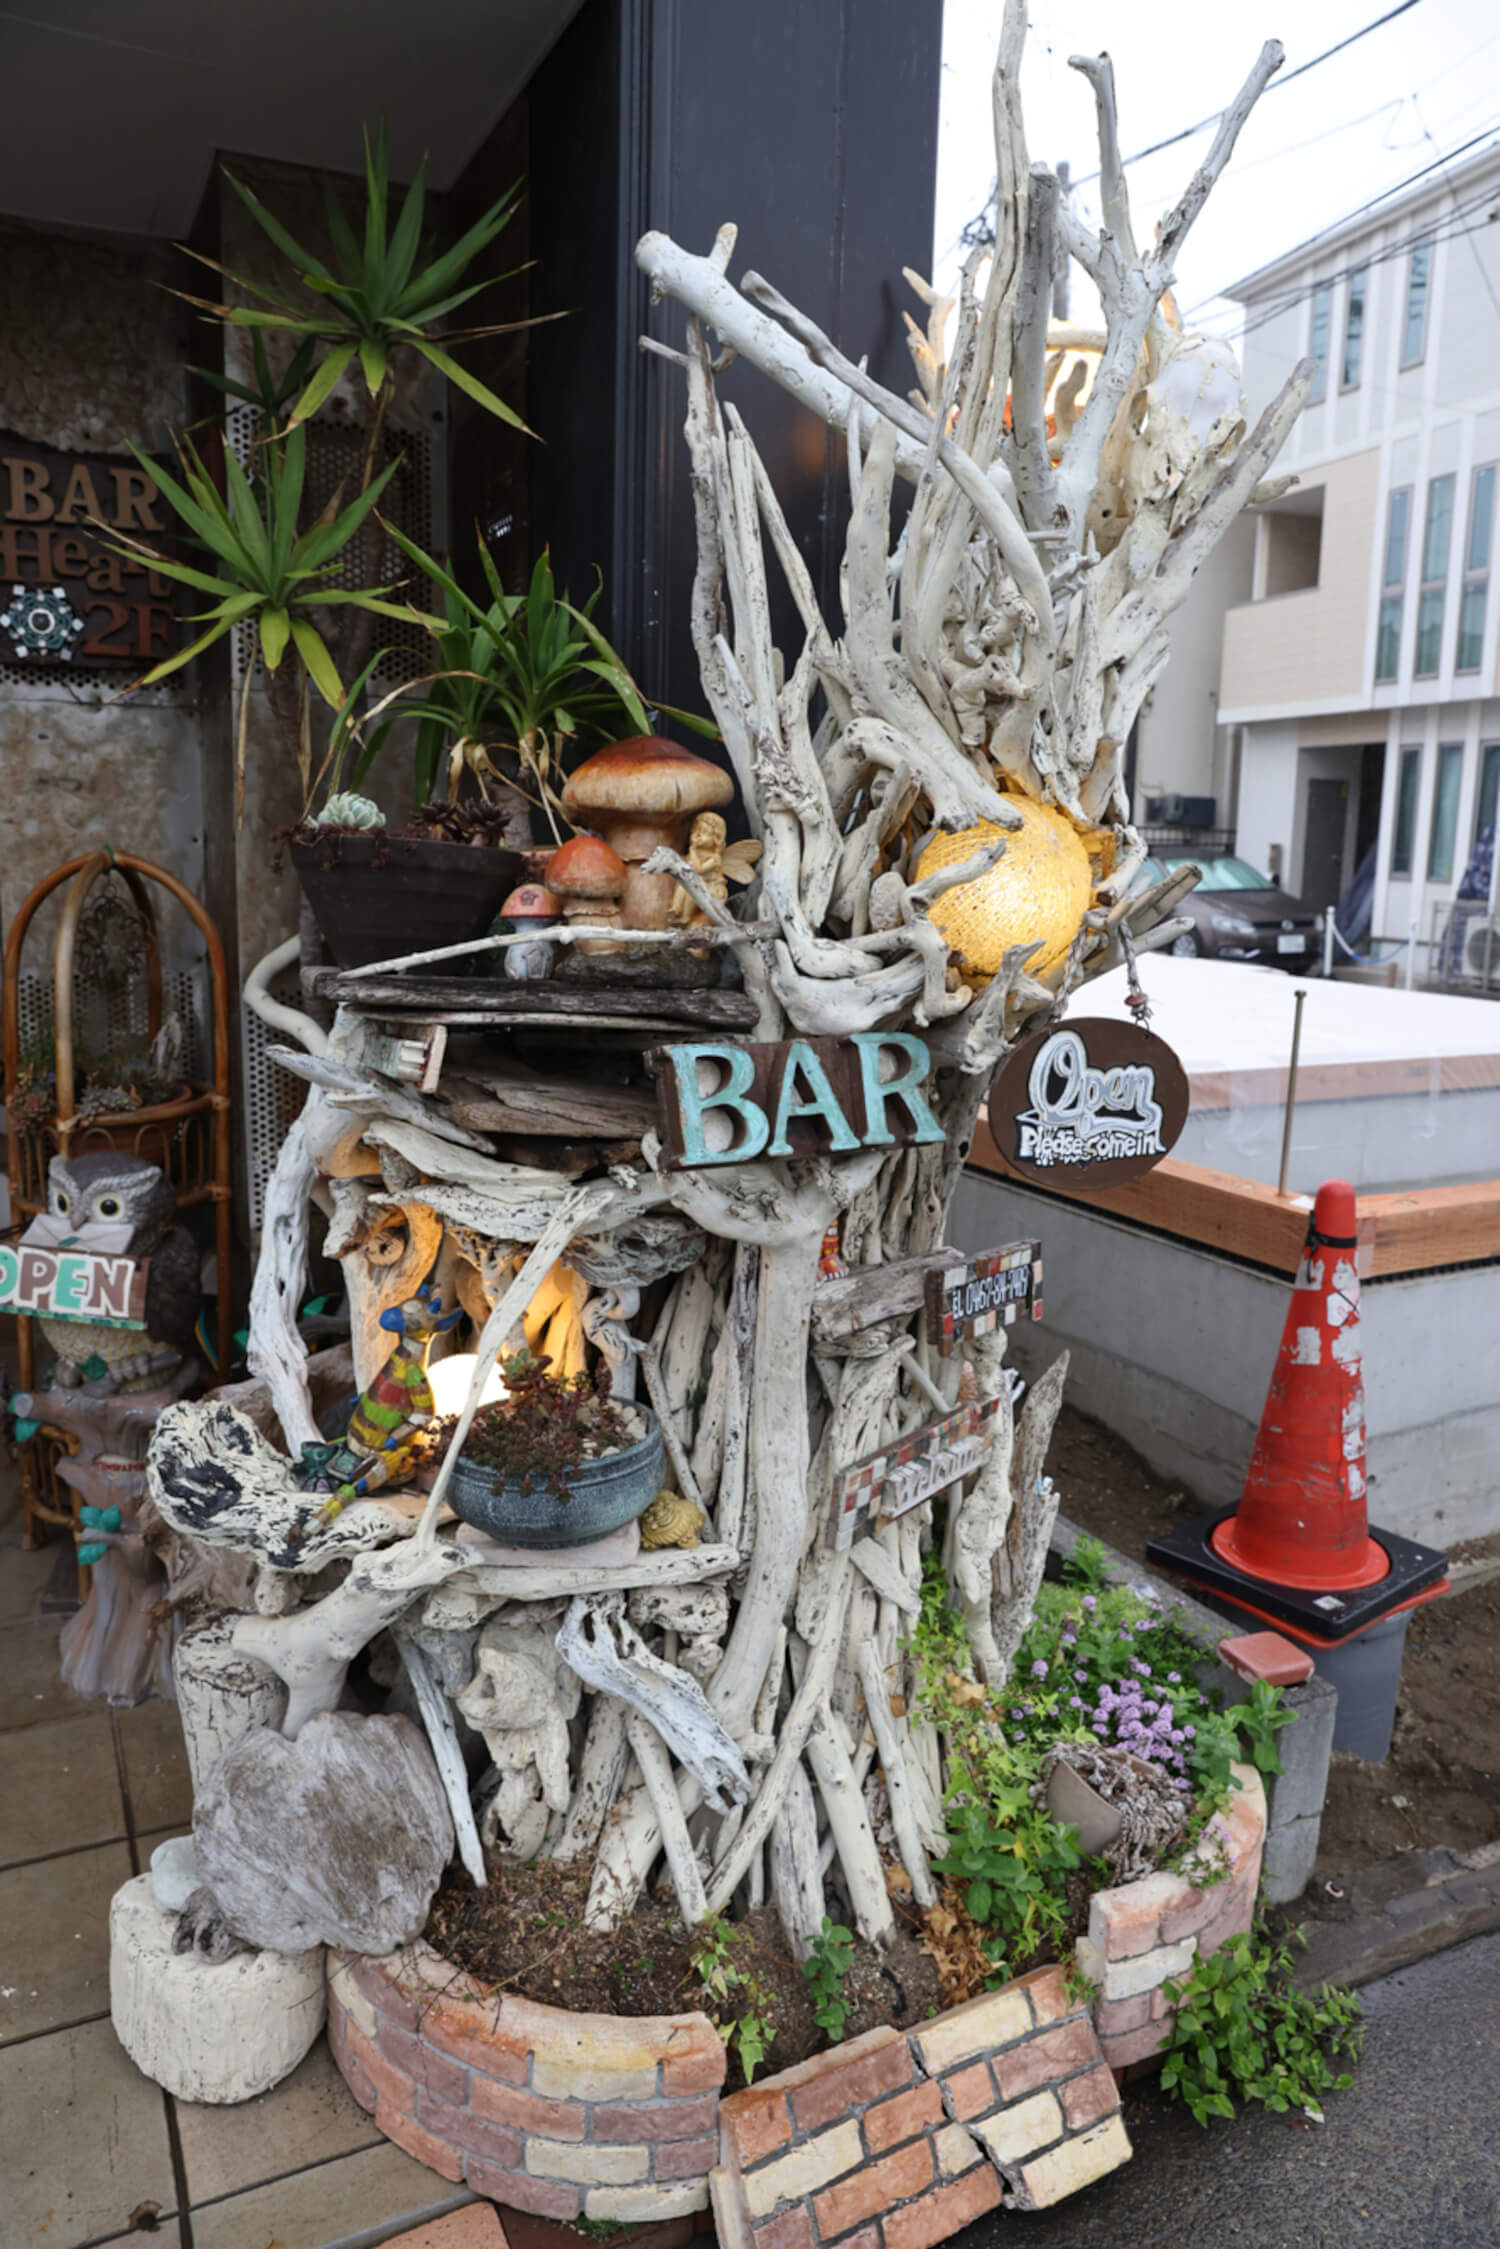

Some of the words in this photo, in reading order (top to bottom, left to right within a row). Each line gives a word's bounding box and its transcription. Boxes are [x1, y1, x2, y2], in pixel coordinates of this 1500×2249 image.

[3, 457, 165, 531] BAR
[83, 601, 175, 657] 2F
[667, 1031, 946, 1165] BAR
[1022, 1029, 1163, 1137] Open
[1019, 1124, 1083, 1166] Please
